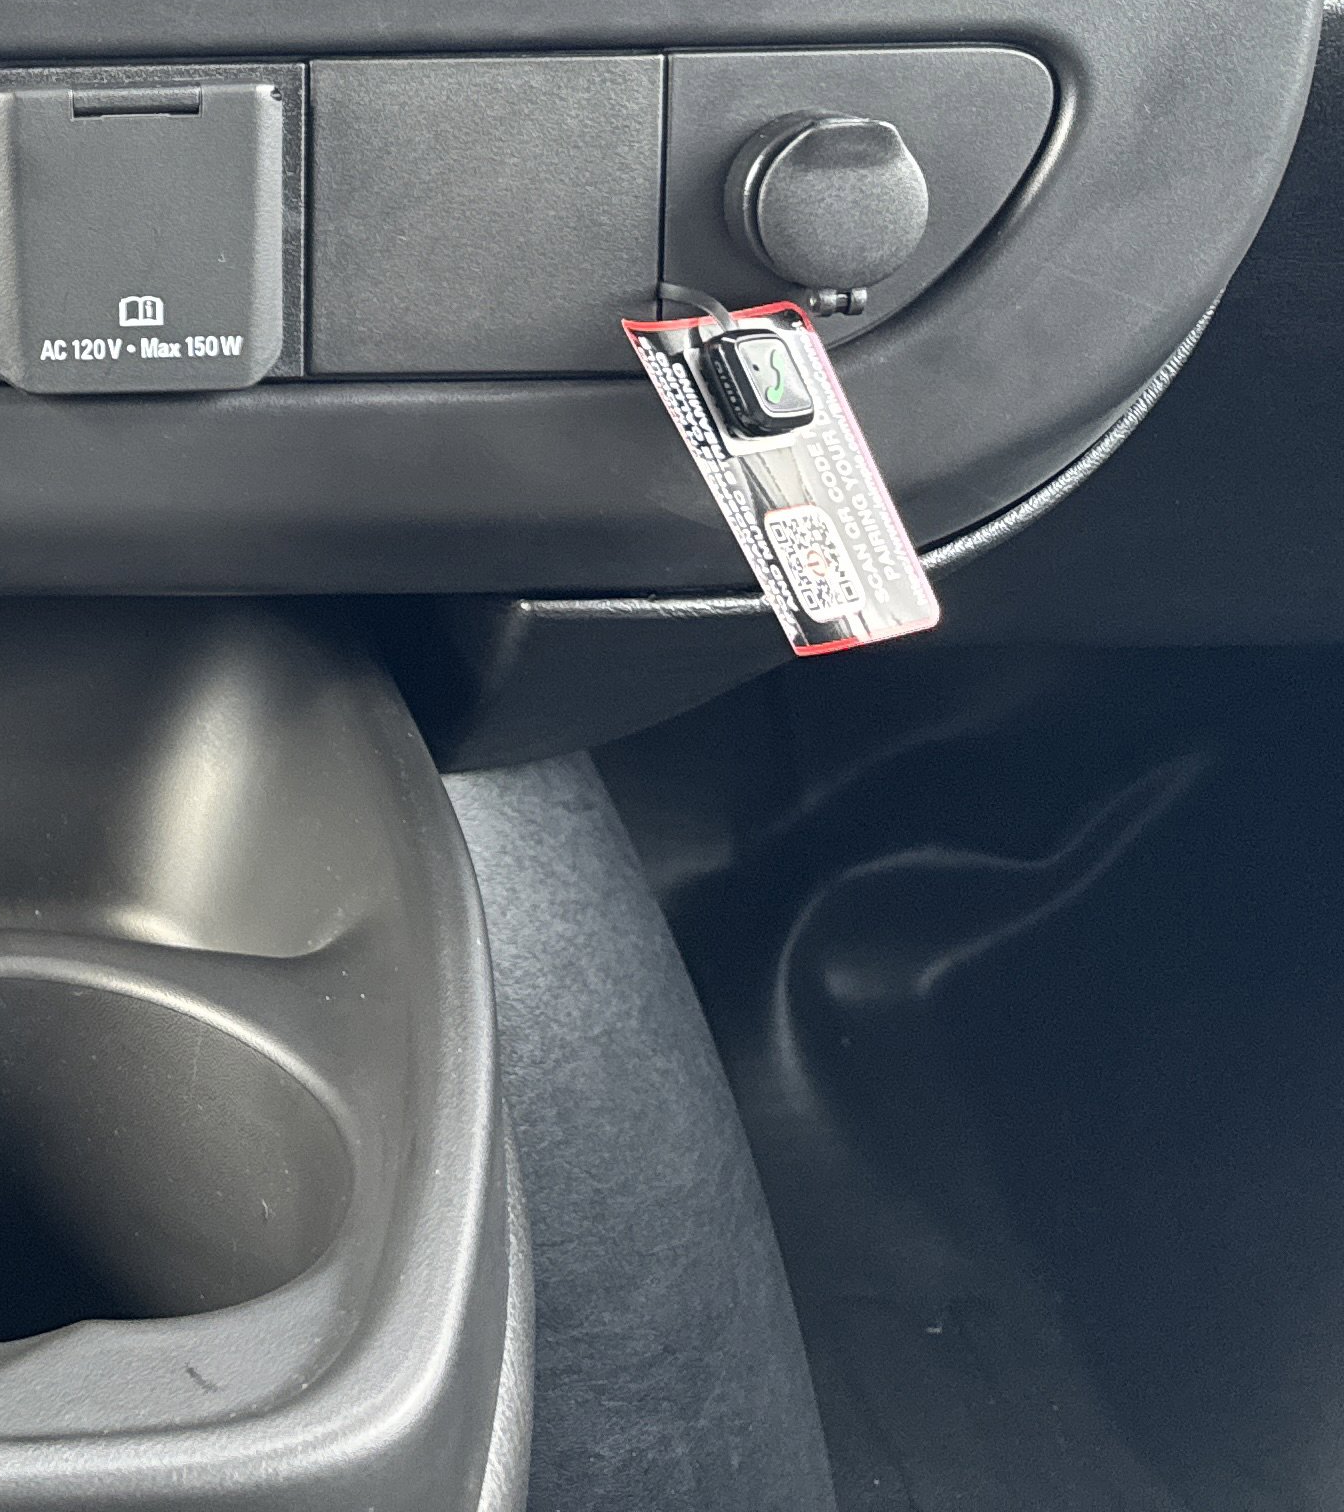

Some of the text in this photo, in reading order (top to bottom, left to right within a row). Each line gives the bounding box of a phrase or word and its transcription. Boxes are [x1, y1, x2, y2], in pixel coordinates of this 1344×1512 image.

[40, 339, 67, 361] AC
[140, 337, 182, 359] Max
[670, 363, 737, 484] STREAMING
[805, 441, 845, 502] CODE
[820, 429, 901, 580] PAIRING YOUR
[835, 506, 863, 538] QR
[852, 542, 891, 602] SCAN
